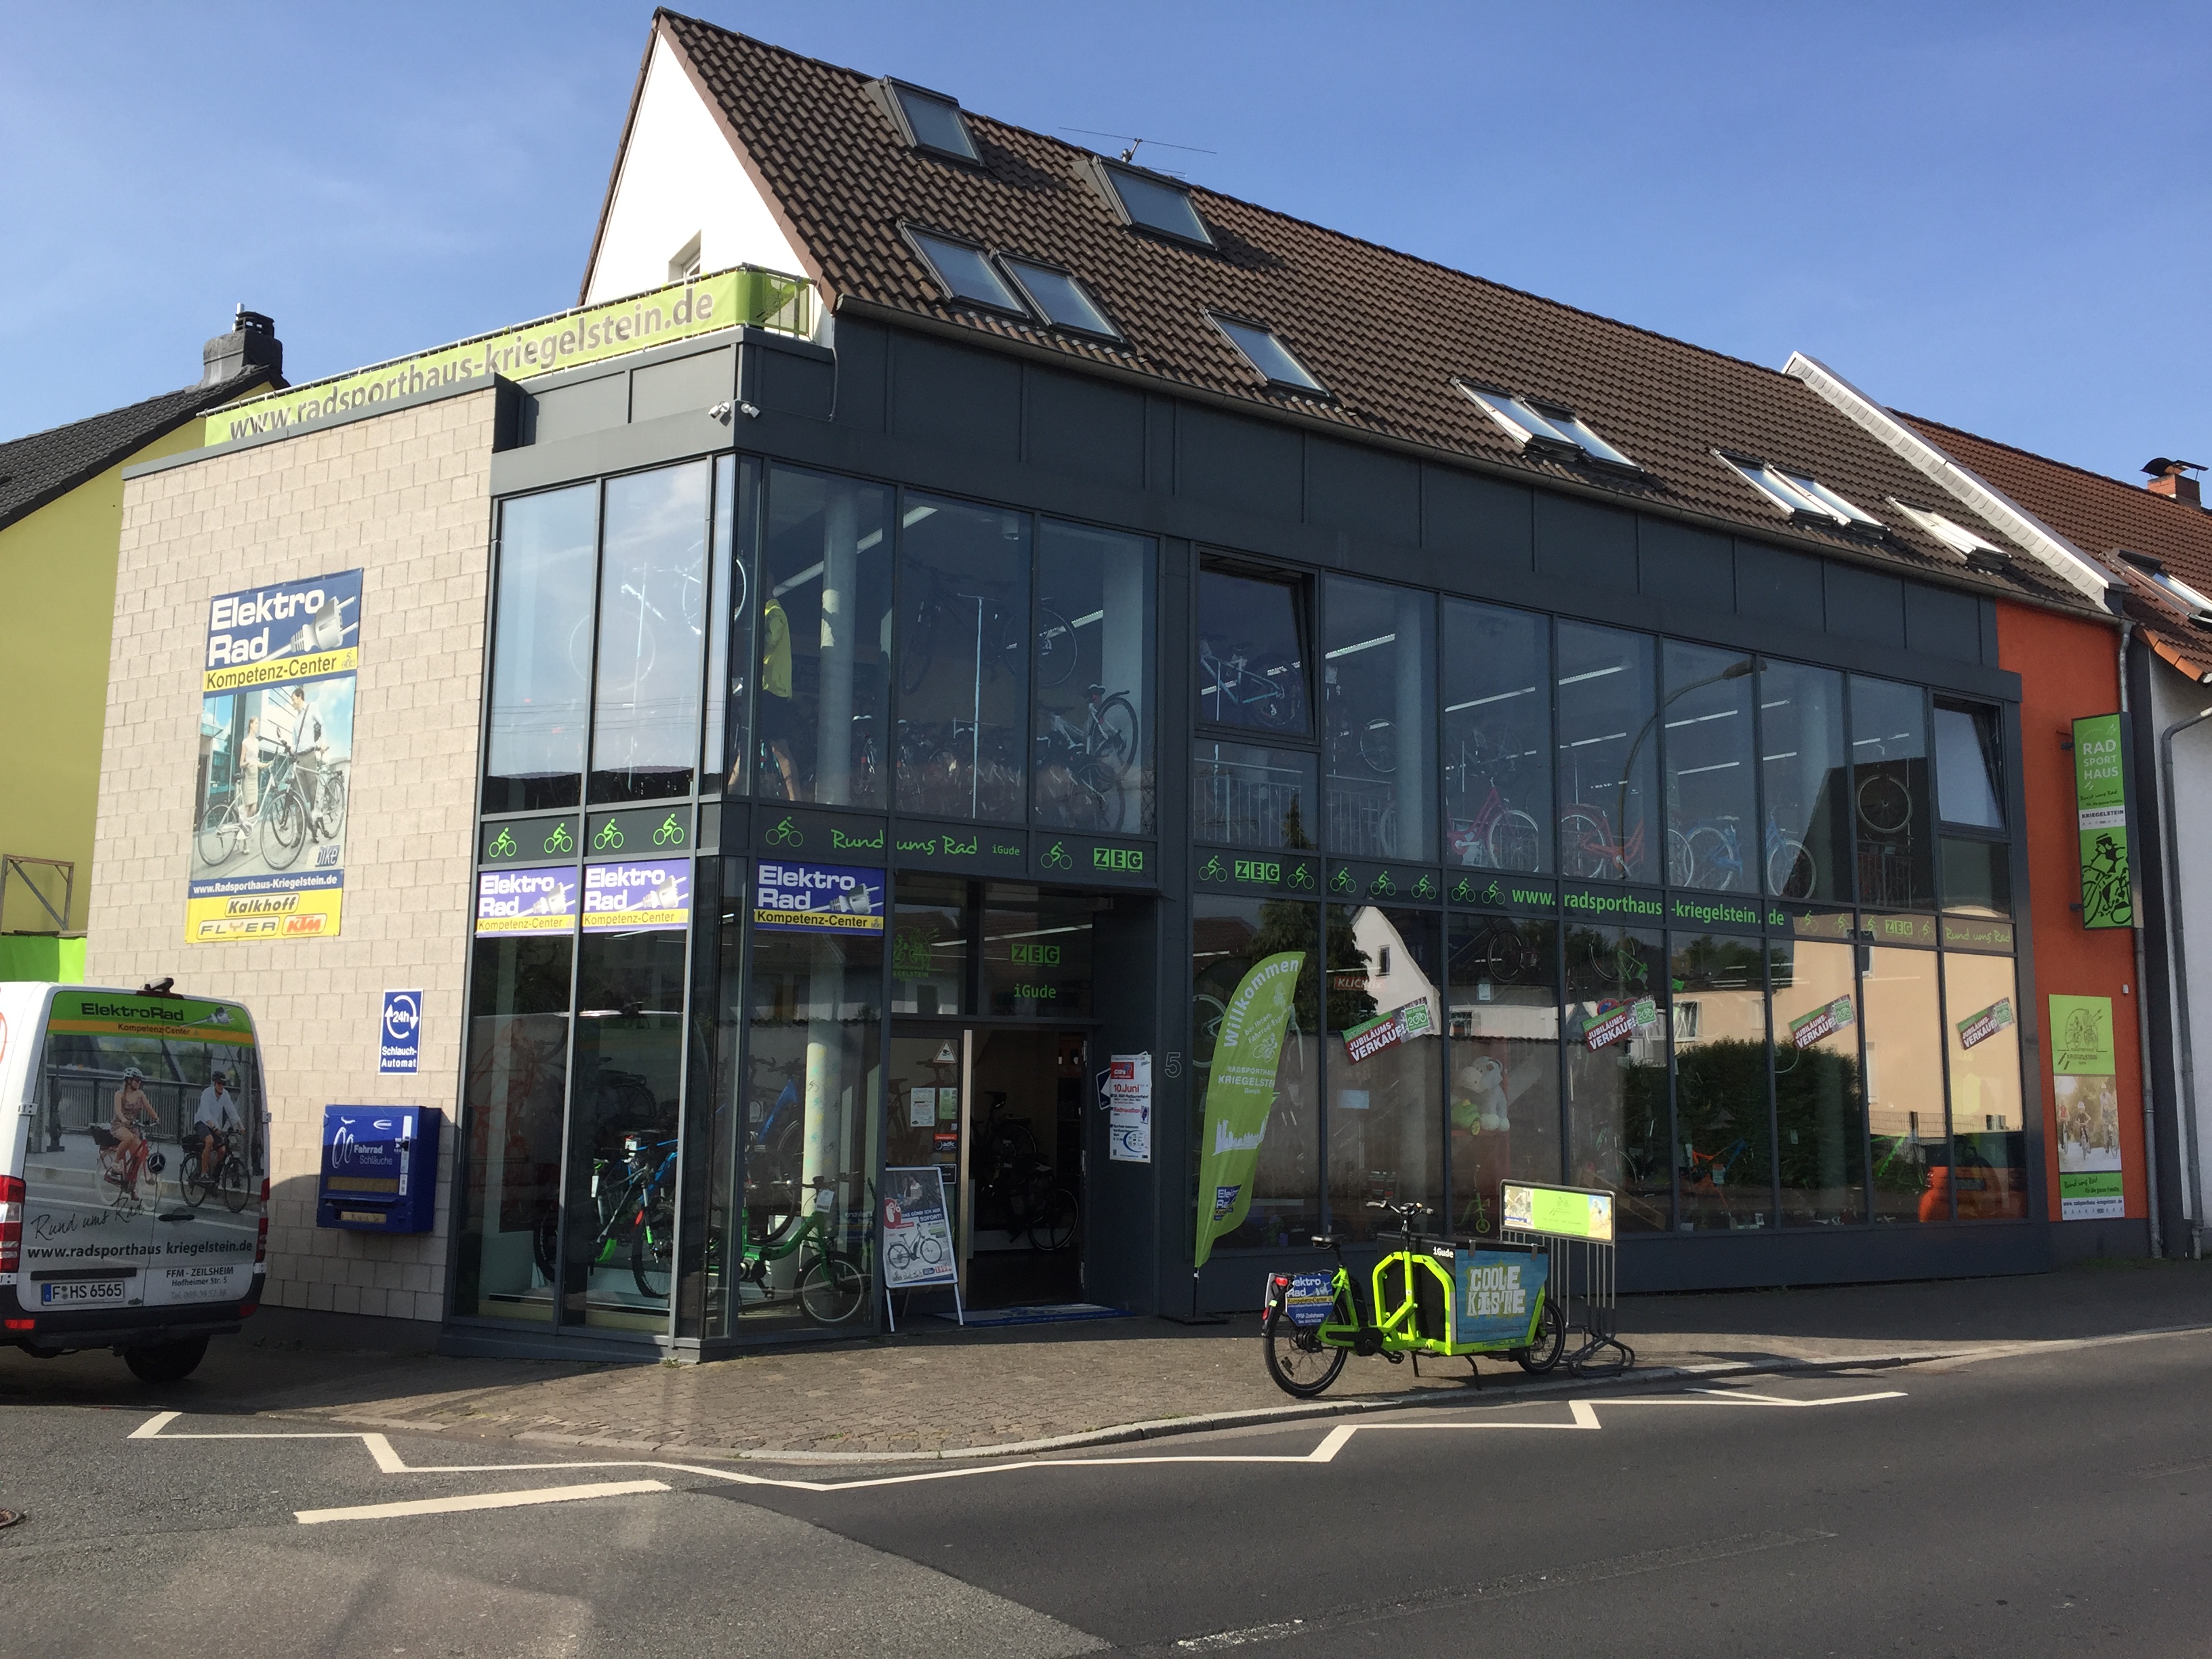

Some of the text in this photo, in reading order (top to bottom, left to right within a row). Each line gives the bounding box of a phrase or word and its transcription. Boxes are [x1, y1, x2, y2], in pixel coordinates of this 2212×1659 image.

[230, 287, 714, 439] www.radsporthaus-kriegelstein.de
[211, 589, 325, 631] Elektro
[208, 628, 269, 667] Rad
[207, 656, 337, 689] Kompetenz-Center
[2083, 739, 2116, 755] RAD
[2083, 755, 2117, 767] SPORT
[2084, 766, 2119, 779] HAUS
[2082, 810, 2124, 819] KRIEGELSTEIN
[831, 829, 1020, 856] Rund ums Rad iGude
[1094, 848, 1143, 869] ZEG
[586, 863, 665, 889] Elektro
[759, 865, 856, 890] Elektro
[1235, 861, 1279, 881] ZEG
[193, 874, 337, 894] www.Radsporthaus-Kriegelstein.de
[482, 874, 554, 895] Elektro
[228, 897, 297, 914] Kalkhoff
[479, 895, 520, 918] Rad
[585, 889, 628, 911] Rad
[758, 888, 811, 909] Rad
[1512, 889, 1556, 905] www.
[1564, 890, 1662, 915] radsporthaus
[1768, 908, 1784, 926] de
[200, 921, 276, 935] FLYER
[287, 916, 322, 933] KTM
[478, 917, 563, 932] Kompetenz-Center
[584, 911, 675, 927] Kompetenz-Center
[757, 910, 868, 928] Kompetenz-Center
[1885, 920, 1913, 935] ZEG
[1945, 926, 2011, 944] Rund ums Rad
[1012, 944, 1061, 964] ZEG
[1014, 983, 1057, 999] iGude
[81, 1002, 184, 1021] ElektroRad
[1224, 960, 1298, 1047] Willkommen
[392, 1011, 409, 1023] 24h
[118, 1023, 190, 1036] Kompetenz-Center
[1349, 1021, 1394, 1051] JUBILÄUMS-
[1588, 1015, 1626, 1040] JUBILÄUMS-
[1589, 1017, 1637, 1050] VERKAUF!
[1797, 1017, 1837, 1048] VERKAUF!
[1964, 1019, 1999, 1048] VERKAUF!
[382, 1046, 417, 1057] Schlauch-
[1351, 1023, 1407, 1061] VERKAUF!
[381, 1057, 417, 1068] Automat
[1164, 1052, 1182, 1078] 5
[1227, 1065, 1276, 1077] RADSPORTHAU
[1218, 1075, 1275, 1088] KRIEGELSTE
[354, 1144, 383, 1154] Fahrrad
[359, 1155, 393, 1166] Schläuche
[30, 1213, 78, 1241] Rund
[110, 1197, 146, 1223] Rad
[920, 1213, 943, 1221] SOFORT!
[1433, 1246, 1454, 1258] iGude
[166, 1269, 184, 1278] FFM
[190, 1267, 234, 1277] ZEILSHEIM
[171, 1278, 209, 1286] Hofheimer
[1293, 1277, 1322, 1286] ektro
[1470, 1266, 1521, 1292] COOLE
[52, 1282, 122, 1300] F HS 6565
[1467, 1289, 1525, 1316] KISTE
